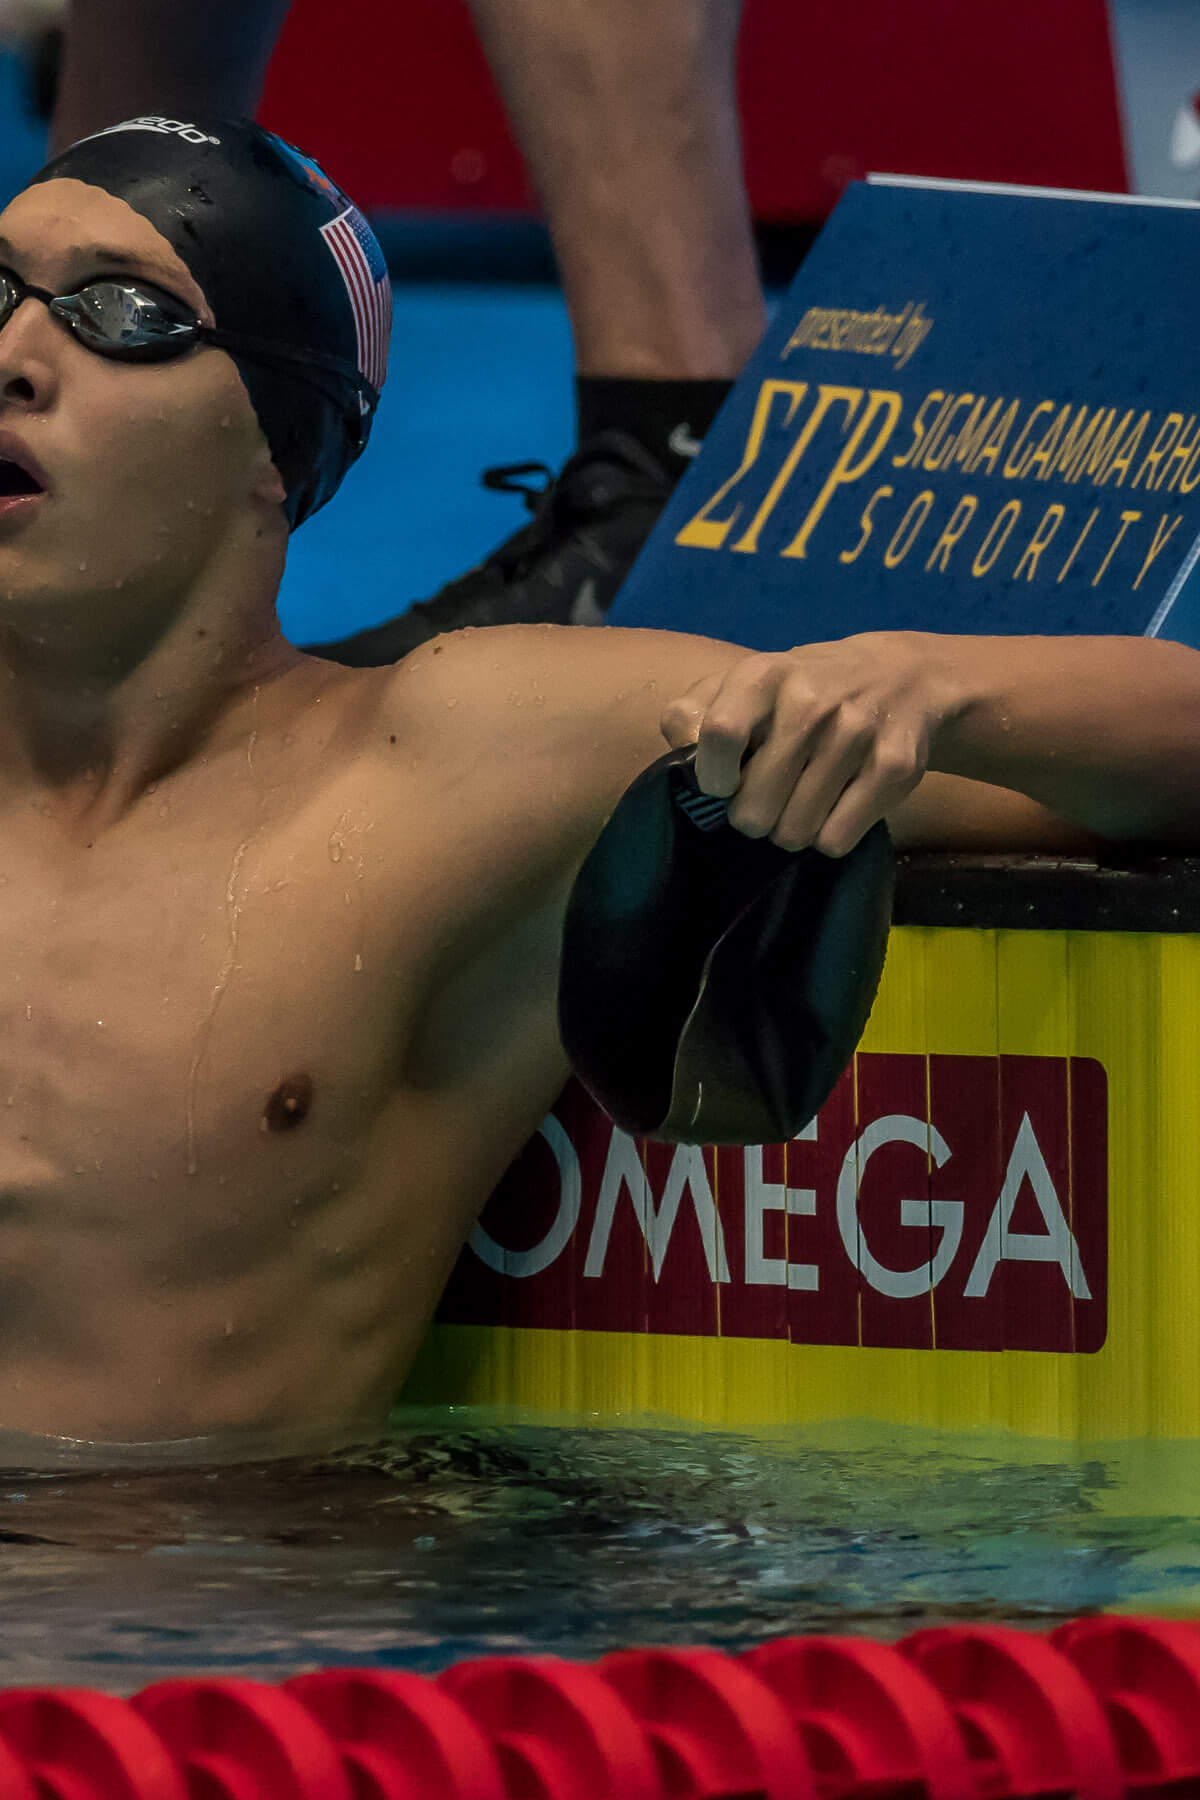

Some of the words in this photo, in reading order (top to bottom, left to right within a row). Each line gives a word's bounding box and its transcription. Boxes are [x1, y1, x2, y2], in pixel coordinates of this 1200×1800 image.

[780, 302, 915, 361] presented
[892, 301, 934, 371] by
[892, 390, 1020, 477] SIGMA
[1003, 399, 1152, 488] GAMMA
[839, 484, 1184, 591] SORORITY
[468, 1109, 1093, 1300] OMEGA
